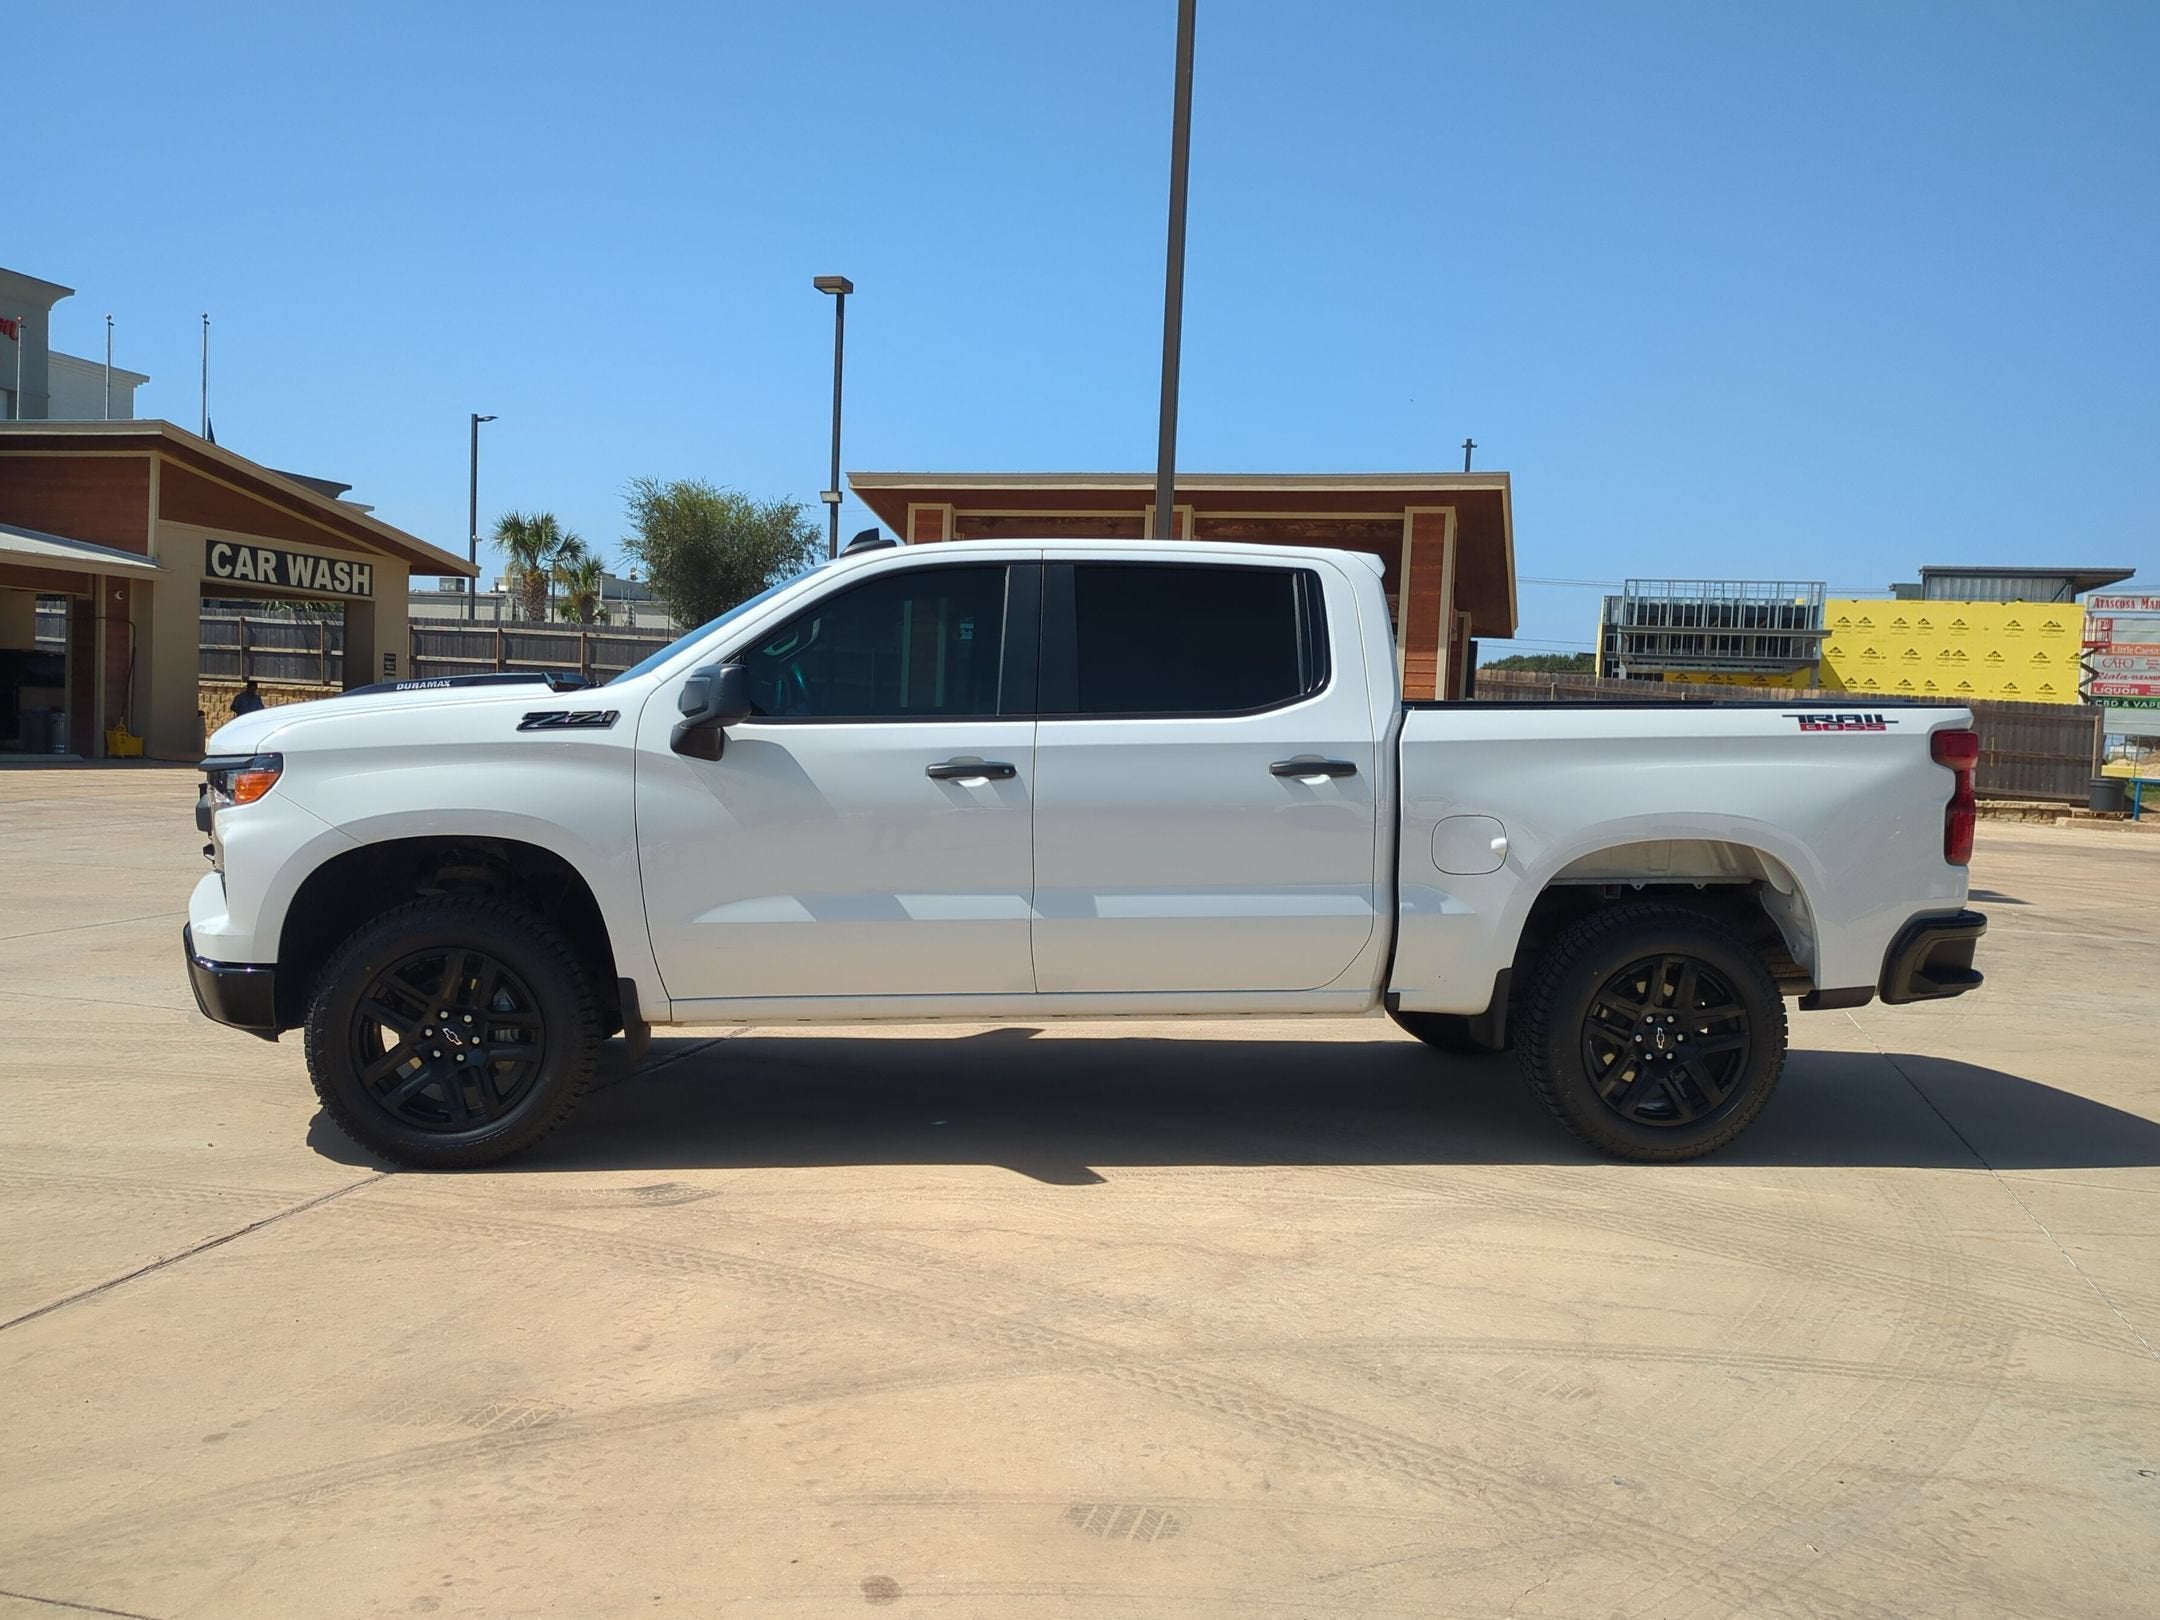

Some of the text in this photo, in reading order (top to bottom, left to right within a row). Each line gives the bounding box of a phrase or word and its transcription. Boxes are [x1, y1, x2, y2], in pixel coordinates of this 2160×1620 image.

[211, 543, 370, 595] CAR WASH
[2111, 645, 2133, 655] Little
[396, 680, 452, 691] DURAMAX
[2093, 686, 2139, 695] LIQUOR
[2095, 699, 2119, 708] CBD
[2121, 700, 2130, 708] &
[516, 710, 622, 733] Z71
[1782, 714, 1899, 724] TRAIL
[1799, 723, 1887, 732] BOSS
